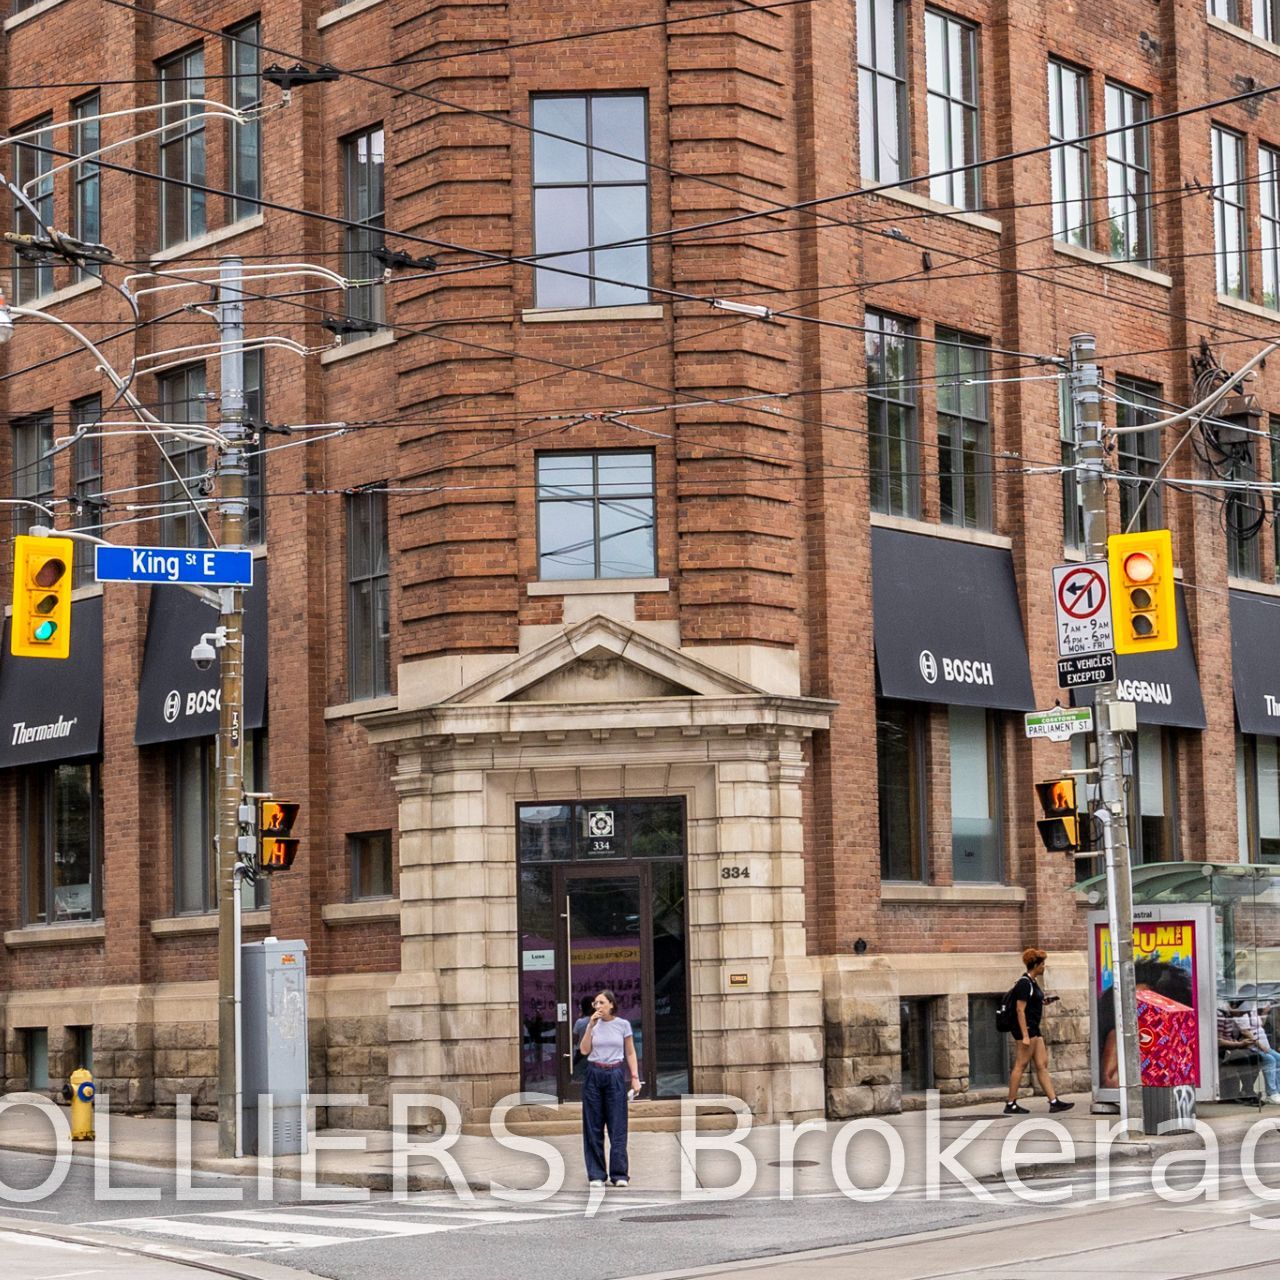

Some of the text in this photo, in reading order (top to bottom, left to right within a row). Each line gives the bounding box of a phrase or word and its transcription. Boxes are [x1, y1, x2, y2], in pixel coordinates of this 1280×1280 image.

[132, 551, 215, 580] King St E
[1068, 644, 1085, 652] MON
[1093, 641, 1105, 649] FRI
[1076, 656, 1112, 669] VEHICLES
[942, 657, 994, 686] BOSCH
[1067, 670, 1106, 684] EXCEPTED
[1116, 679, 1172, 705] AGGENAU
[1028, 722, 1073, 735] PARLIAMENT
[593, 841, 610, 851] 334
[721, 866, 750, 879] 334
